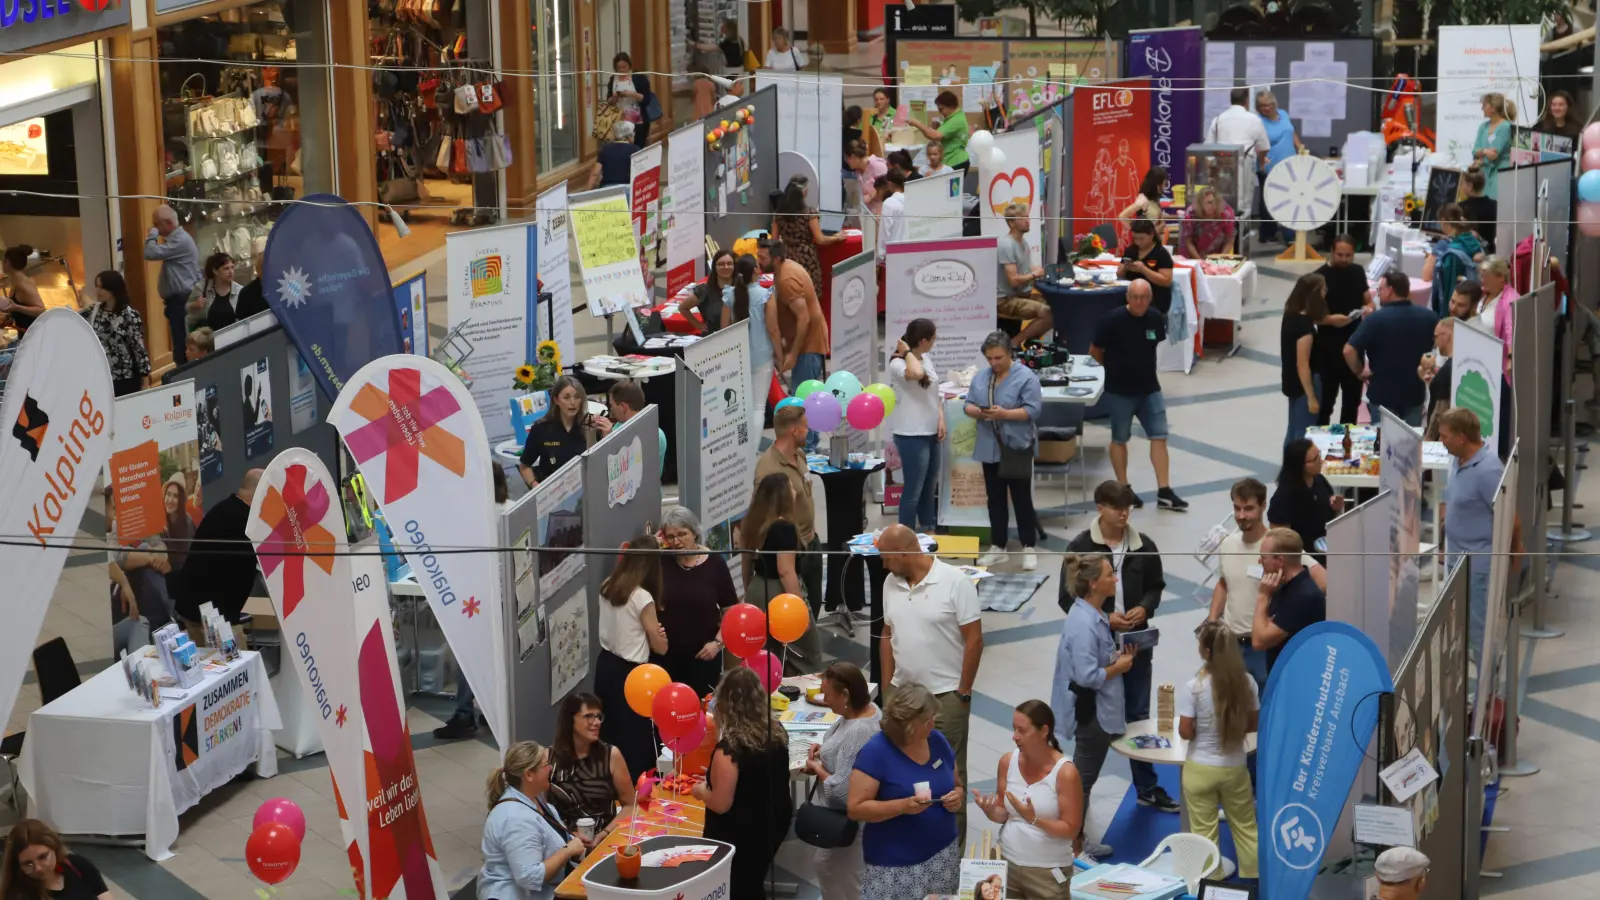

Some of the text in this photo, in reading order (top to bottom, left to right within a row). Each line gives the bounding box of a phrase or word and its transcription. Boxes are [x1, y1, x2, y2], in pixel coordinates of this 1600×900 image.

[1092, 92, 1114, 110] EFL
[164, 408, 192, 421] Kolping
[26, 389, 104, 551] Kolping
[118, 461, 148, 474] Wir fördern
[119, 468, 157, 484] Menschen und
[120, 482, 147, 494] vermitteln
[202, 669, 248, 711] ZUSAMMEN
[204, 690, 250, 732] DEMOKRATIE
[1292, 645, 1338, 792] Der Kinderschutzbund
[206, 716, 242, 753] STÄRKEN!
[1308, 667, 1350, 800] Kreisverband Ansbach
[386, 782, 398, 801] wir
[400, 774, 413, 792] das
[378, 802, 404, 828] Leben
